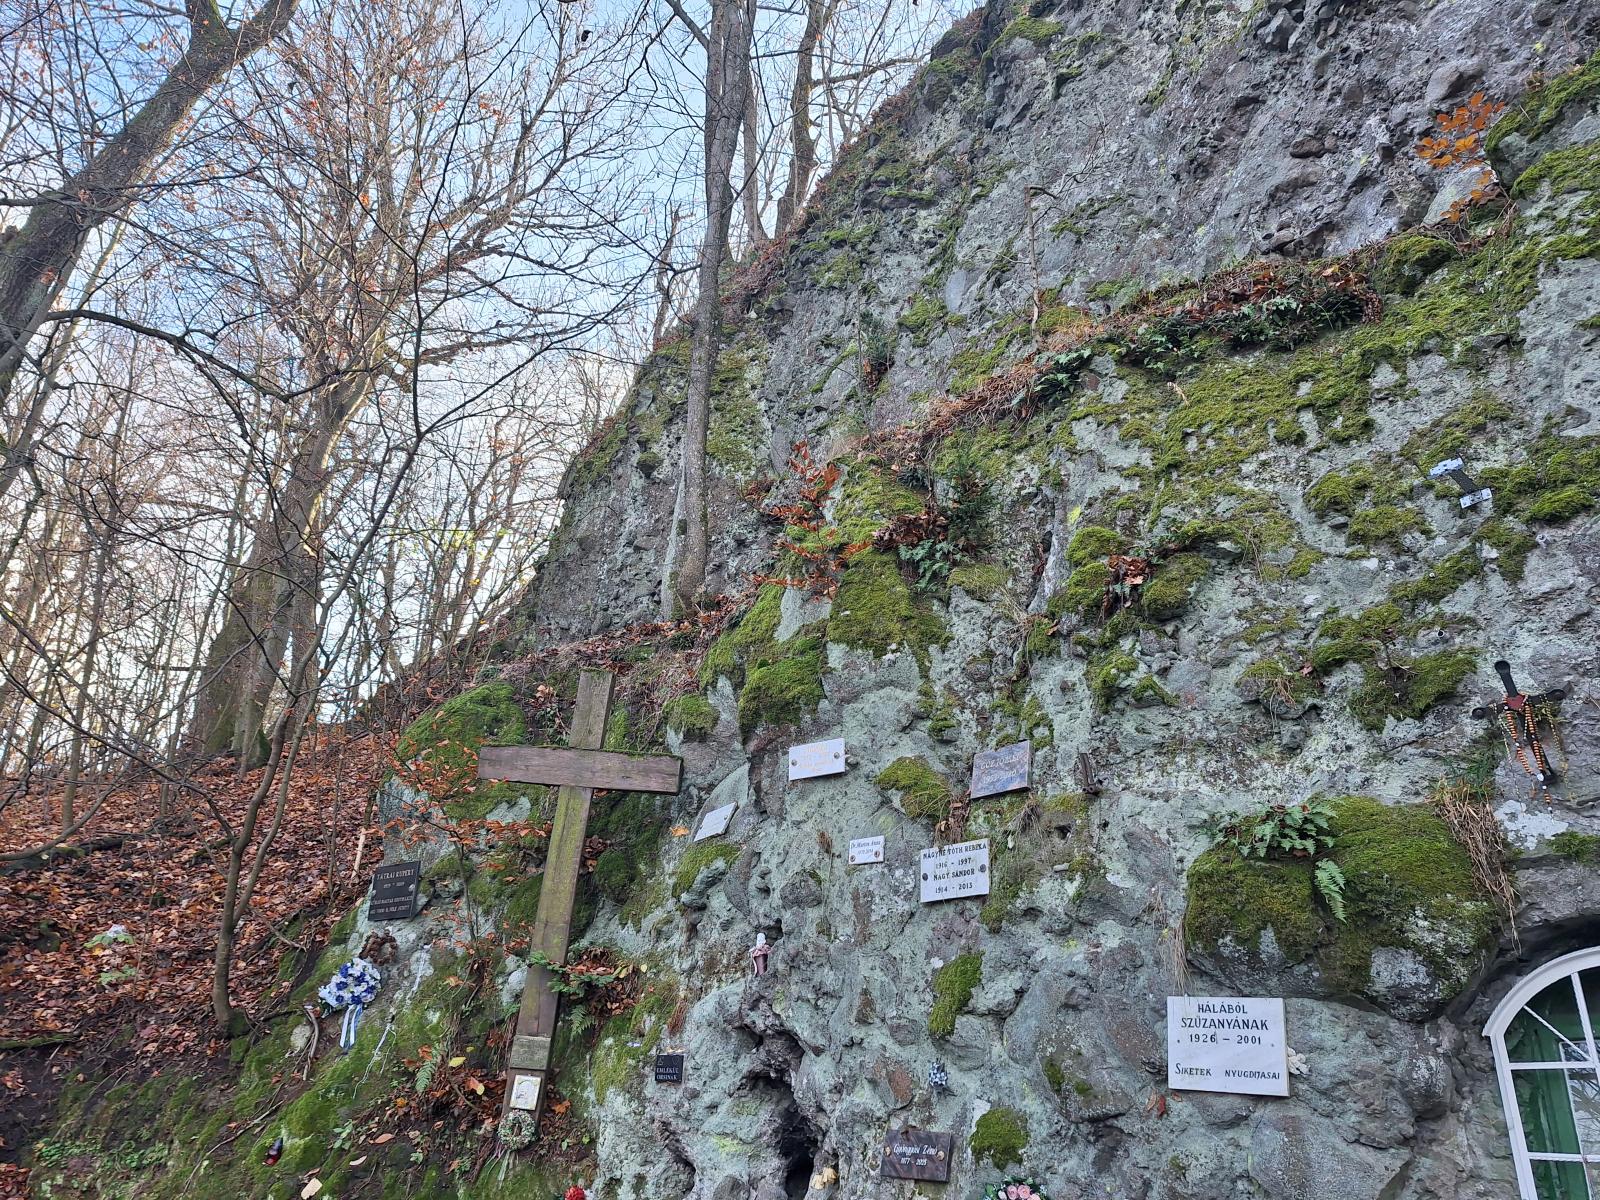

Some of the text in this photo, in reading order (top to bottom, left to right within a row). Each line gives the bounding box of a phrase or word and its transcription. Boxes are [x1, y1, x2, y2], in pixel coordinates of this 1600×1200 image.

[958, 857, 972, 866] 1997
[933, 872, 950, 880] NAGY
[1197, 1000, 1248, 1014] HÁLÁBÓL
[1189, 1033, 1216, 1044] 1926
[1236, 1034, 1261, 1045] 2001
